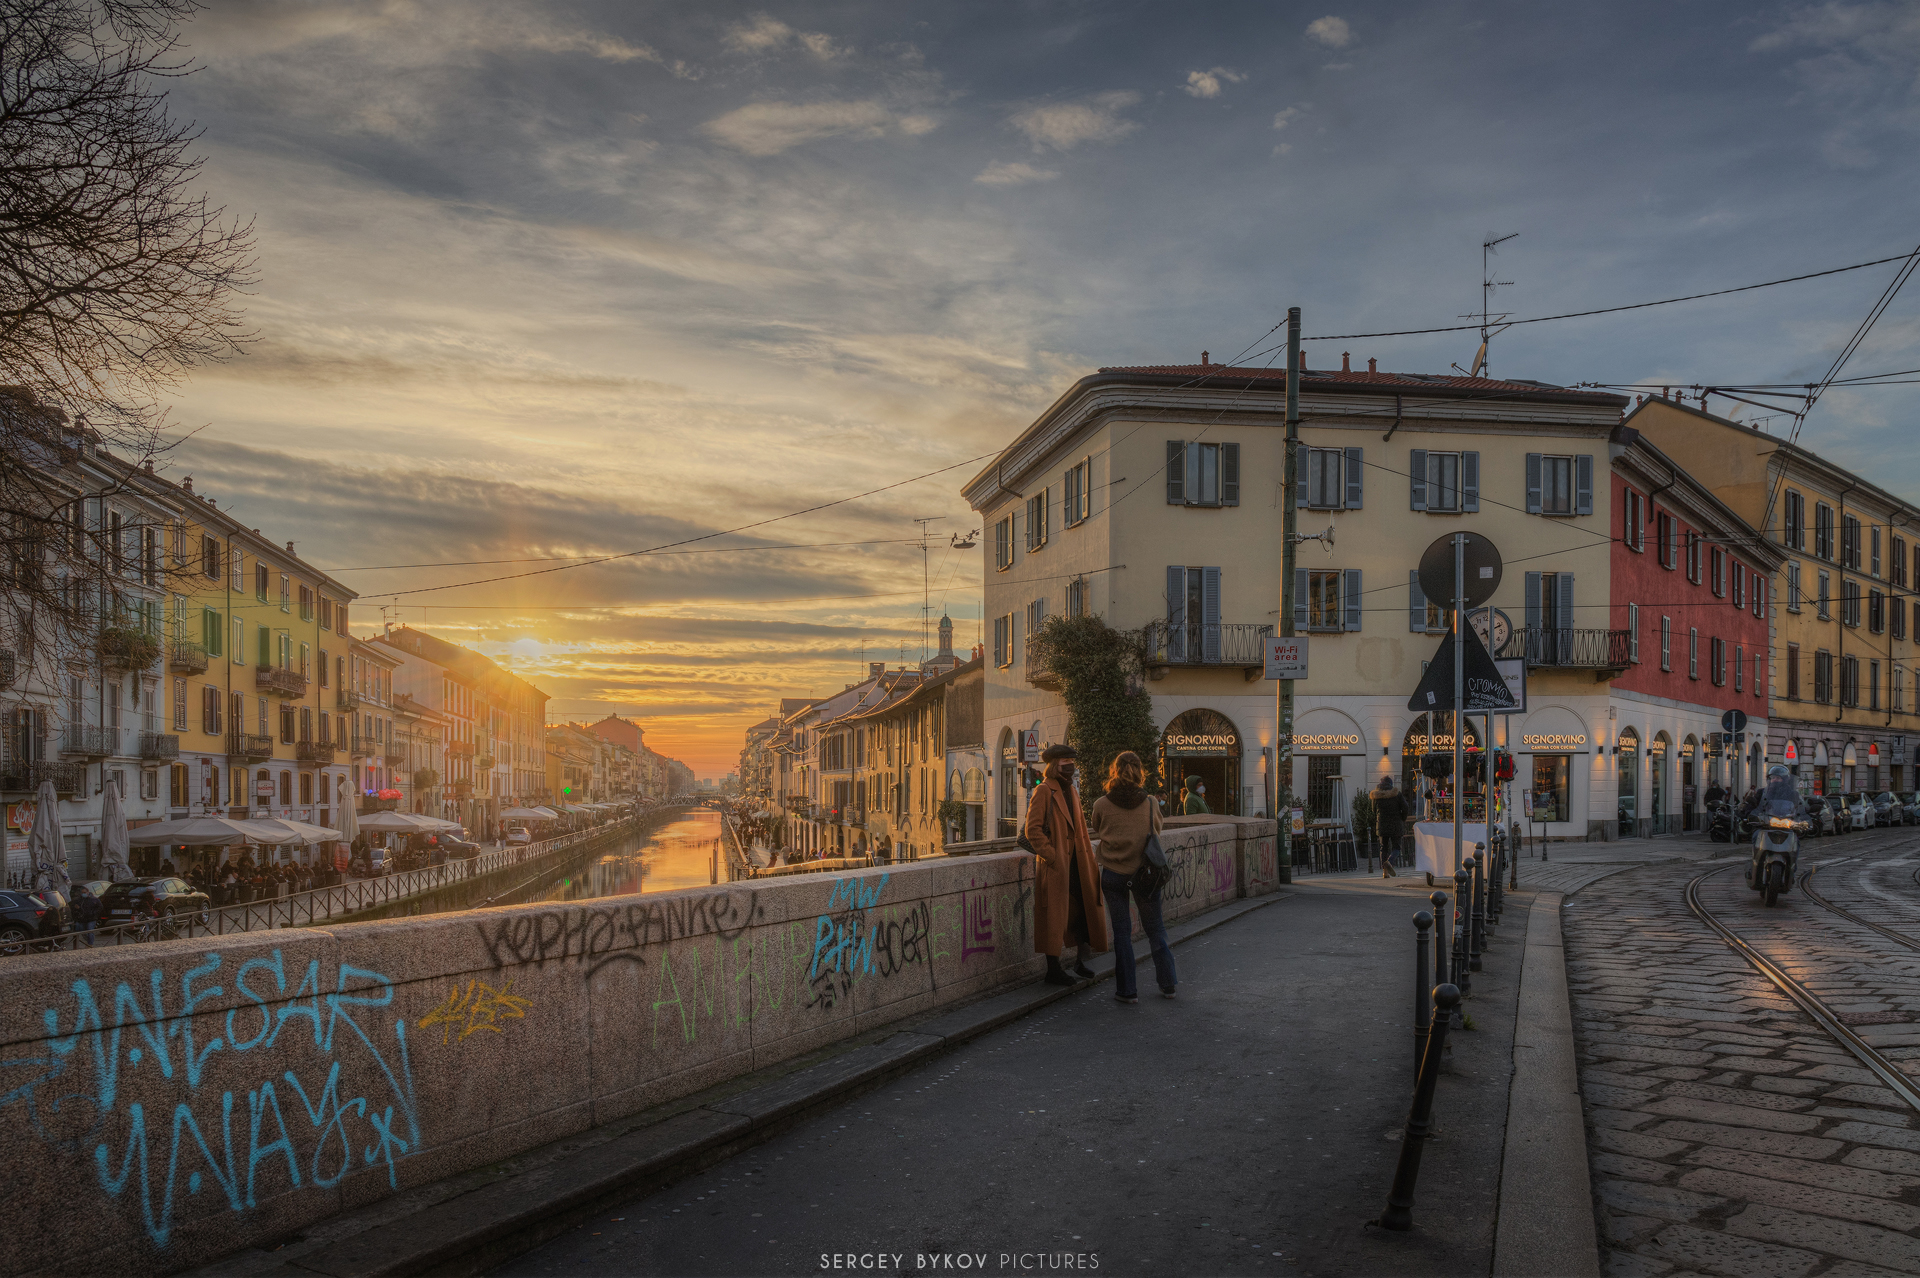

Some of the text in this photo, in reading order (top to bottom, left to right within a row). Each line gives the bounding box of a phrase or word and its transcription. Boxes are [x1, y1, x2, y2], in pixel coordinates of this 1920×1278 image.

[1274, 645, 1298, 654] Wi-Fi
[1167, 734, 1236, 745] SIGNORVINO
[1292, 734, 1359, 745] SIGNORVINO
[1410, 734, 1475, 745] SIGORVO
[1523, 734, 1586, 745] SIGNORVINO
[1895, 735, 1903, 745] T
